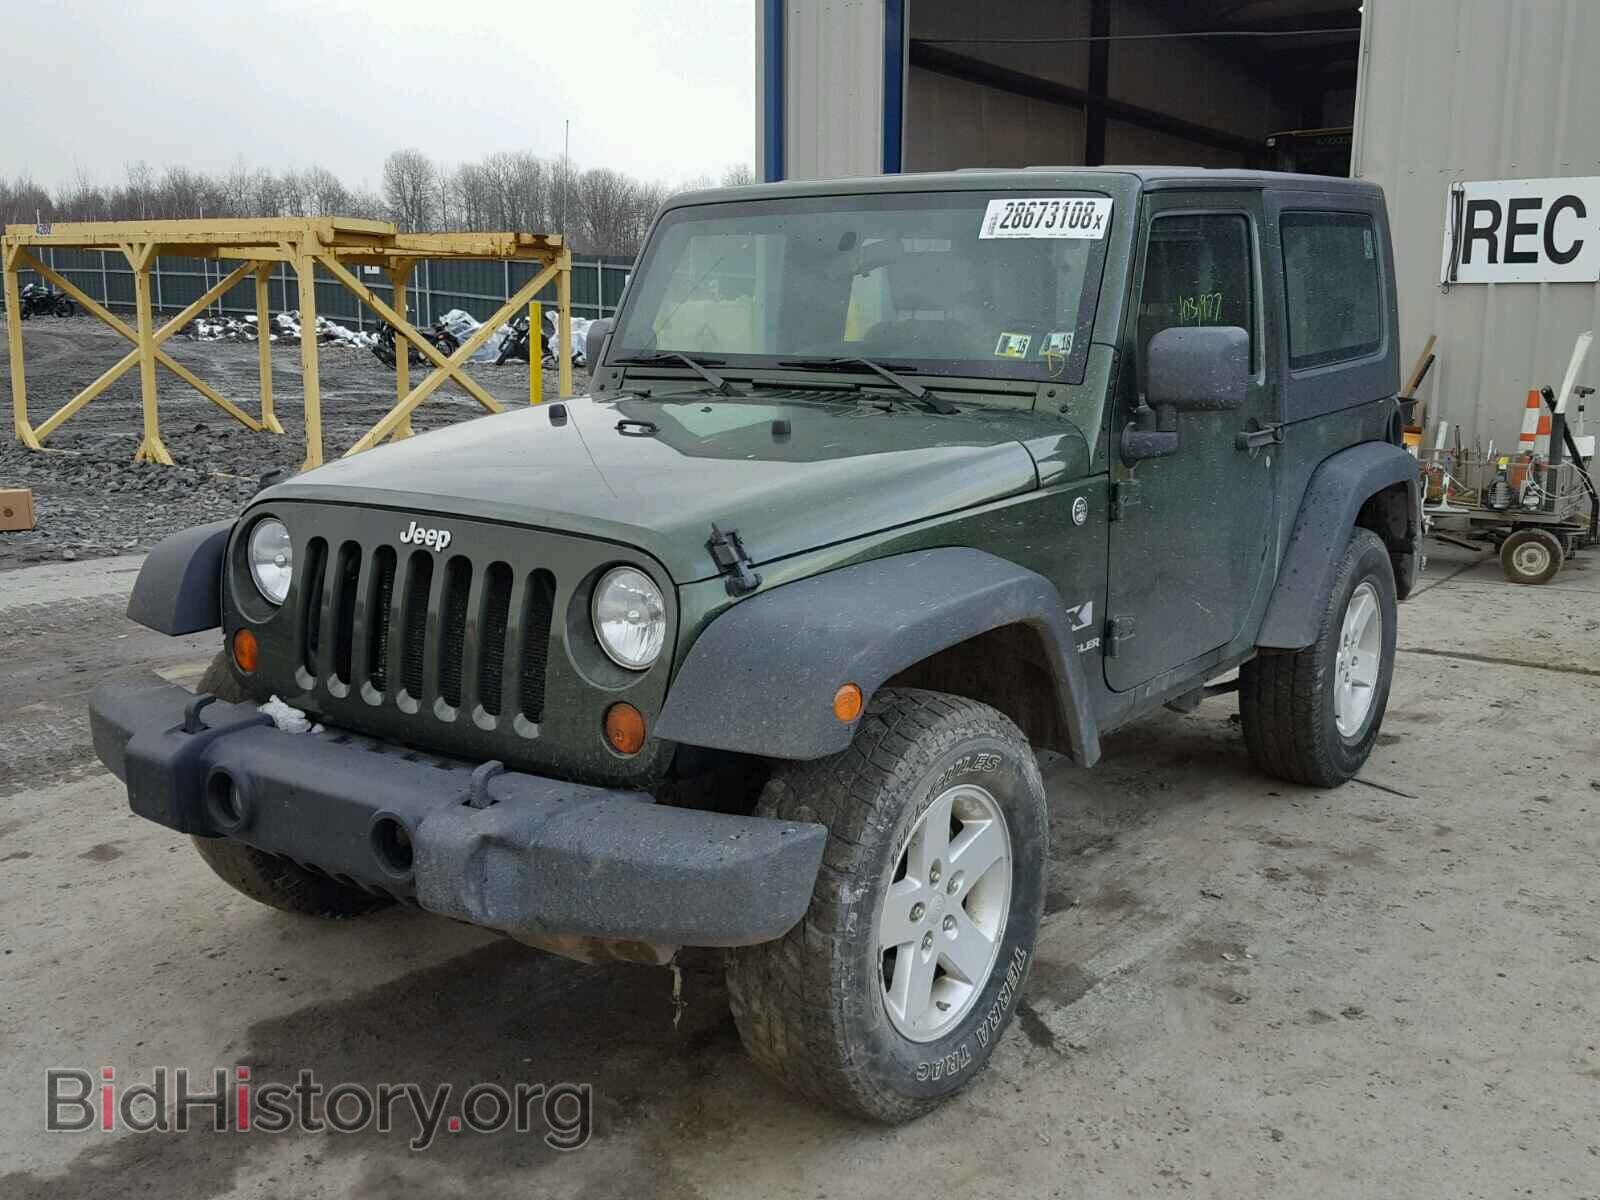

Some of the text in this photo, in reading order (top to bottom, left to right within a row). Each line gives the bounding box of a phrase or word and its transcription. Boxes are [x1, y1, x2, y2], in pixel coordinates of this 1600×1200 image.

[1462, 195, 1587, 265] REC
[400, 521, 451, 552] Jeep
[916, 946, 1027, 1081] TERRA TRAC
